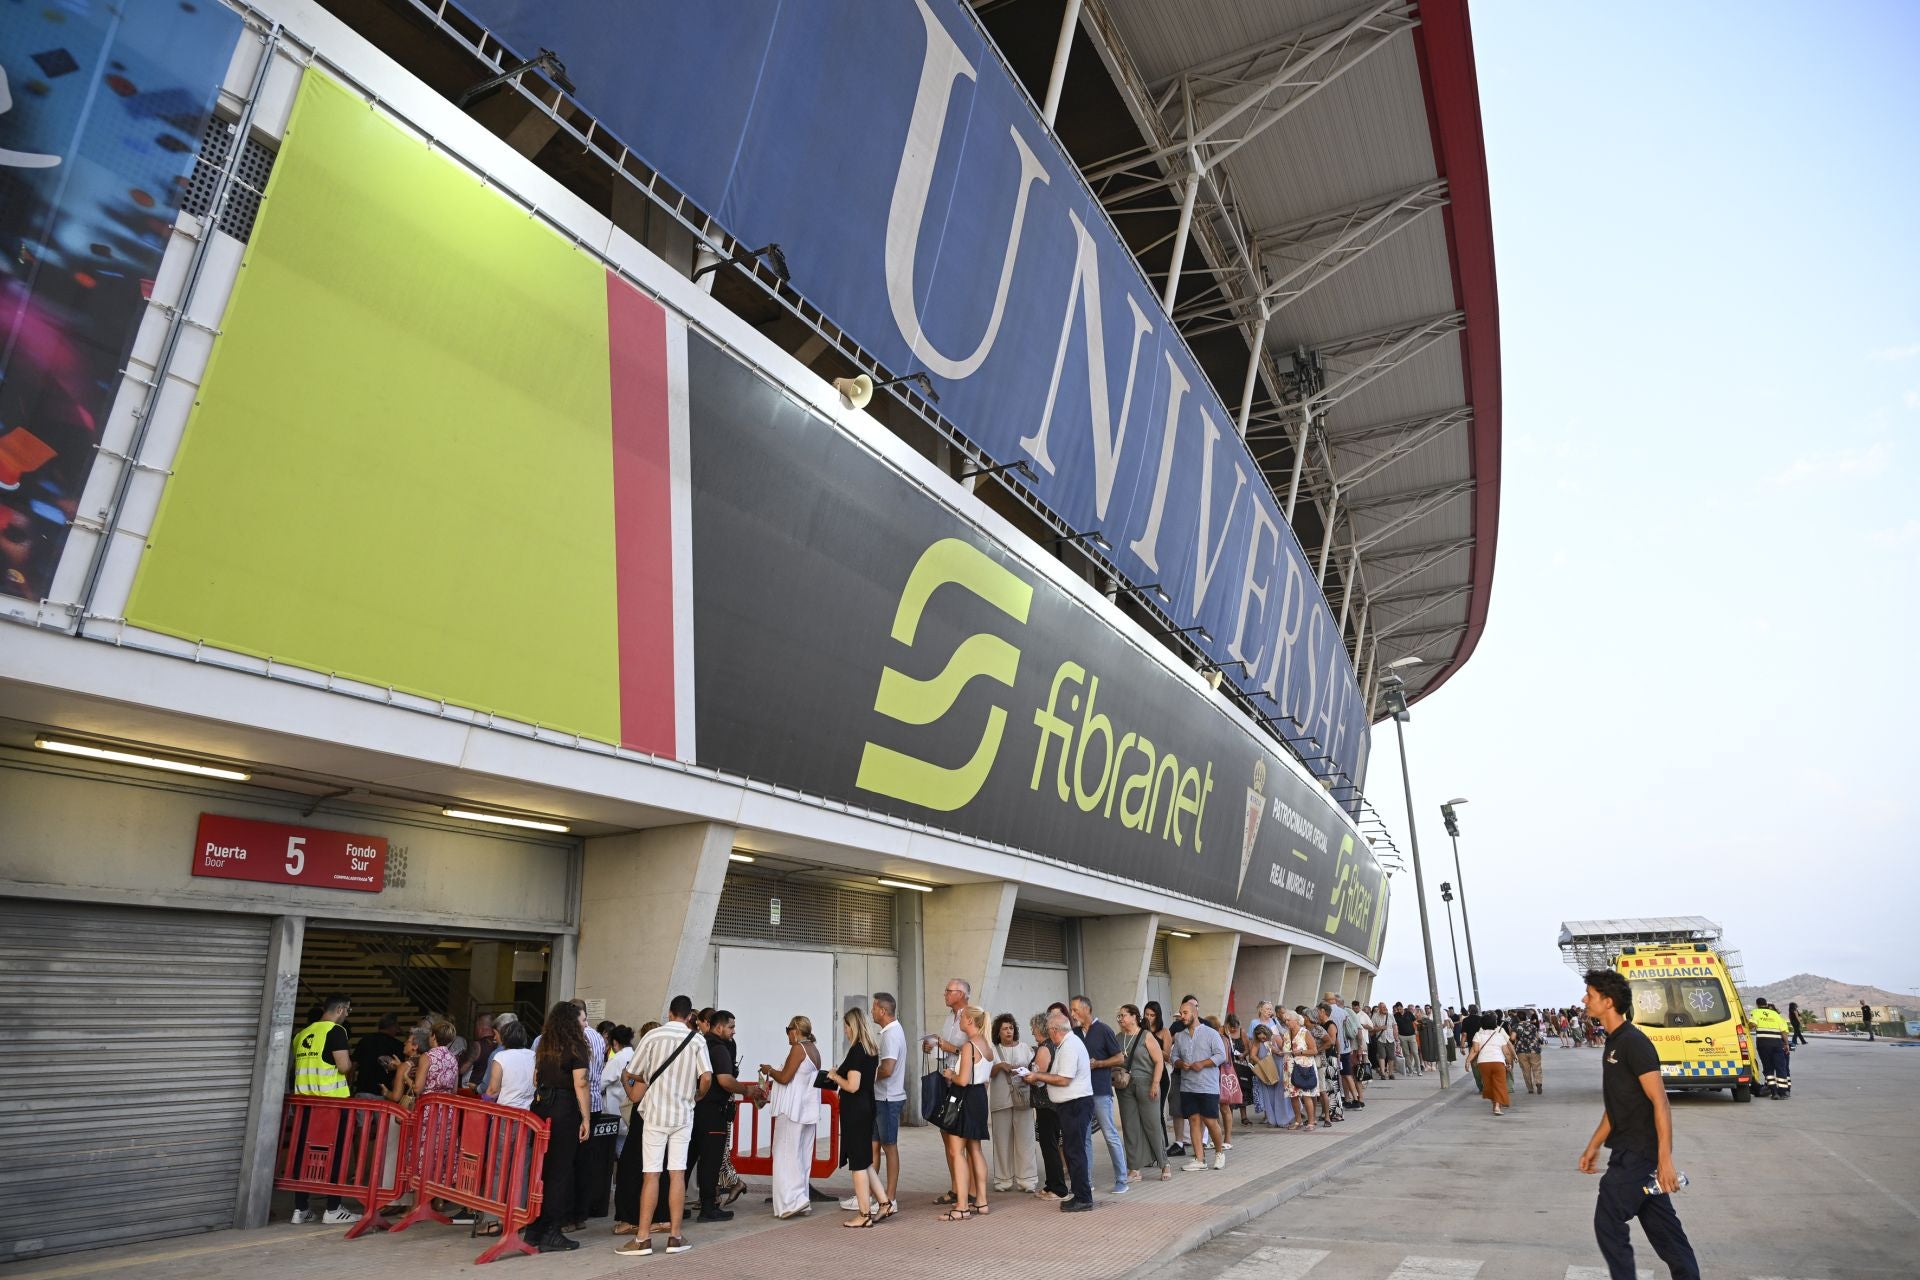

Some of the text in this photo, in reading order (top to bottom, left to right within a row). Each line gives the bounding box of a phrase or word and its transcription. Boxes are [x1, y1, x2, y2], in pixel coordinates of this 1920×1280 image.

[1030, 660, 1214, 854] fibranet
[1272, 797, 1314, 843] PATROCINADOR
[1312, 826, 1329, 855] OFICIAL
[205, 842, 247, 860] Puerta
[285, 836, 306, 876] 5
[346, 843, 377, 859] Fondo
[205, 856, 225, 868] Door
[351, 857, 369, 871] Sur
[1269, 862, 1286, 888] REAL
[1285, 870, 1307, 897] MURCIA
[1629, 966, 1713, 979] AMBULANCIA
[1842, 1010, 1881, 1018] MAESK
